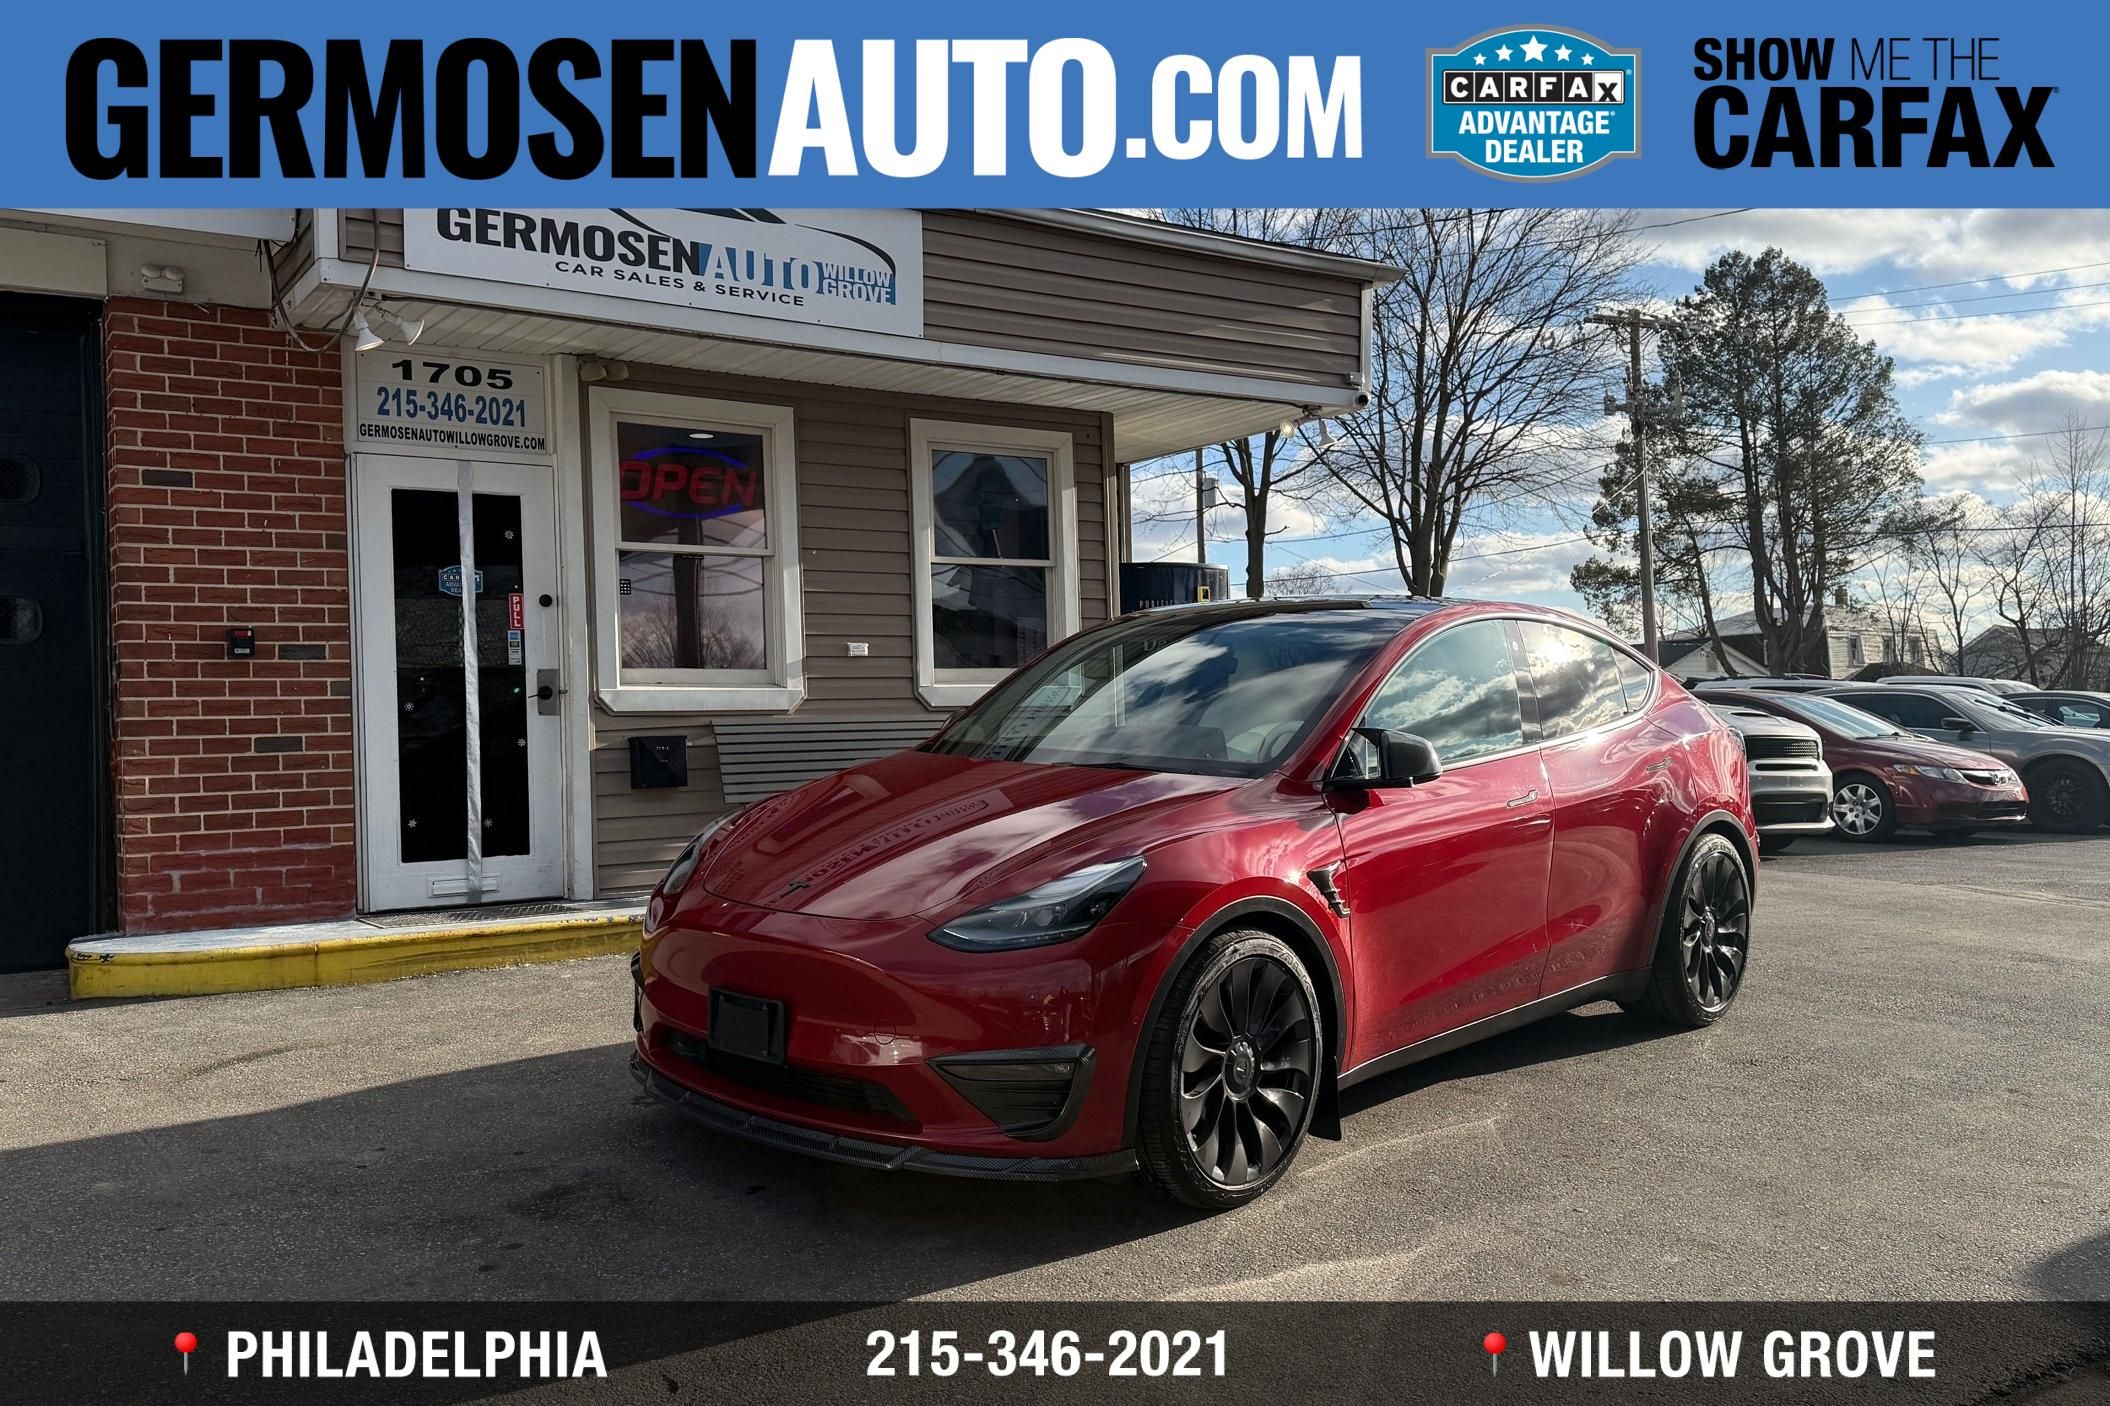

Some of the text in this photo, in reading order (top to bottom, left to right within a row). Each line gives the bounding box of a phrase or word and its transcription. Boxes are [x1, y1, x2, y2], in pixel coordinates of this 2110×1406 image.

[555, 261, 805, 307] CAR SALES & SERVICE
[822, 262, 893, 288] WILLOW
[822, 278, 893, 304] GROVE
[392, 359, 513, 390] 1705
[376, 386, 526, 428] 215-346-2021
[359, 423, 545, 450] GERMOSENAUTOWILLOWGROVE.COM
[619, 460, 758, 507] OPEN
[512, 596, 521, 627] PULL
